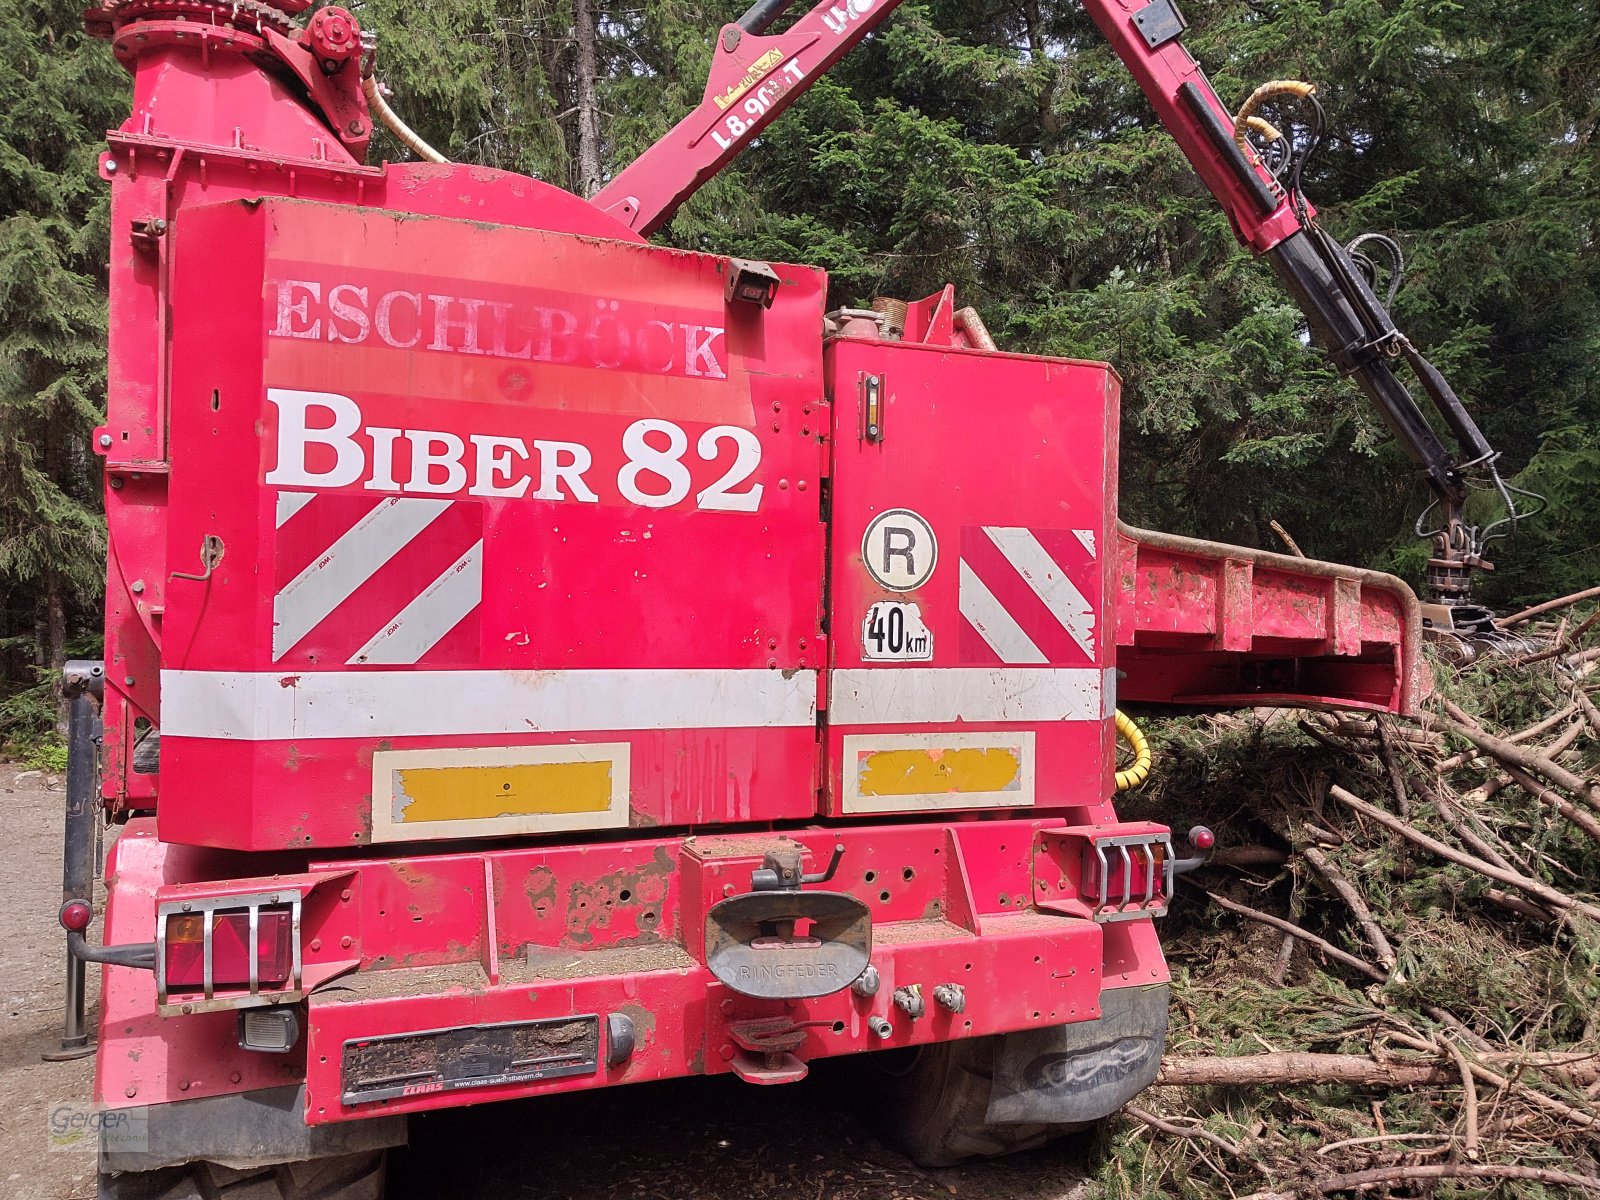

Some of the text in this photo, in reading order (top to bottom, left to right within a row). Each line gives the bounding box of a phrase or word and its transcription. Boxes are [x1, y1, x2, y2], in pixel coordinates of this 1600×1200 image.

[267, 279, 727, 379] ESCHLBÖCK
[617, 418, 765, 512] 82
[883, 526, 916, 576] R
[740, 963, 838, 980] RINGFEDER
[402, 1082, 444, 1096] CLAAS
